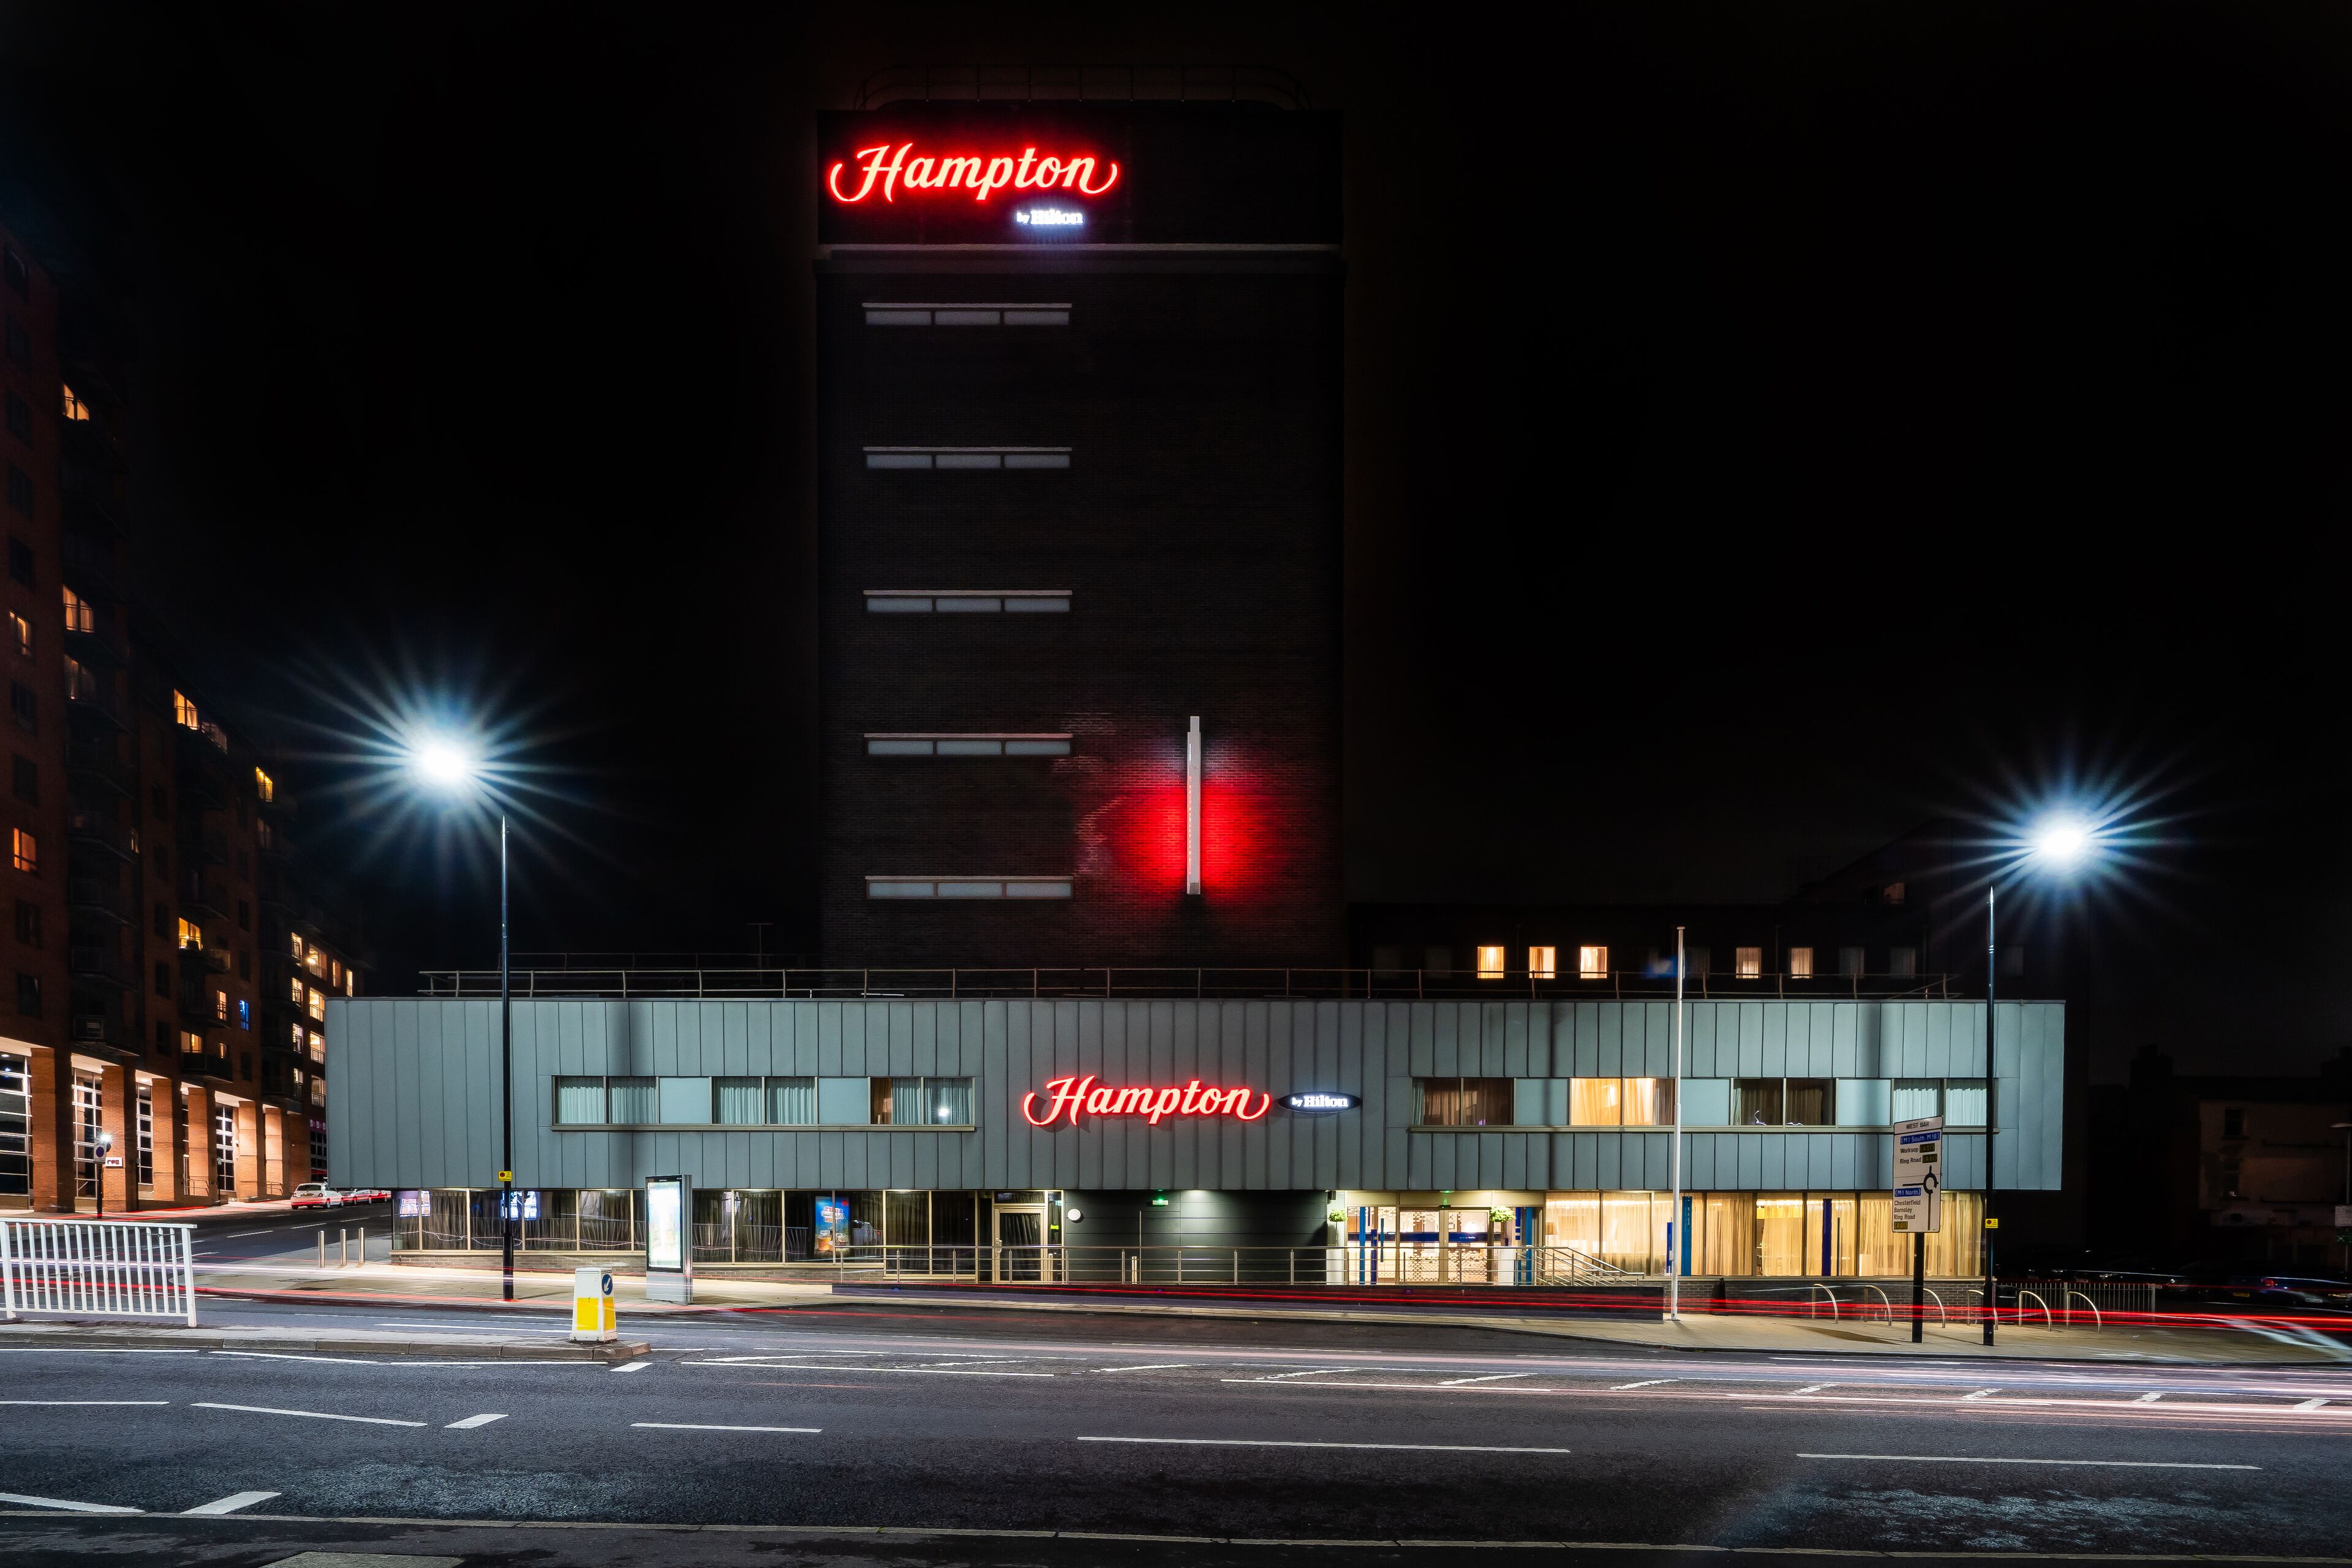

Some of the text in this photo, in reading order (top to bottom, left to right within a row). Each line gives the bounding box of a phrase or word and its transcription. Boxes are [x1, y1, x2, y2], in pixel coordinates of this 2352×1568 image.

[830, 143, 1118, 202] Hampton
[1017, 209, 1083, 225] by Hilton
[1023, 1075, 1269, 1126] Hampton
[1291, 1095, 1349, 1108] by Hilton
